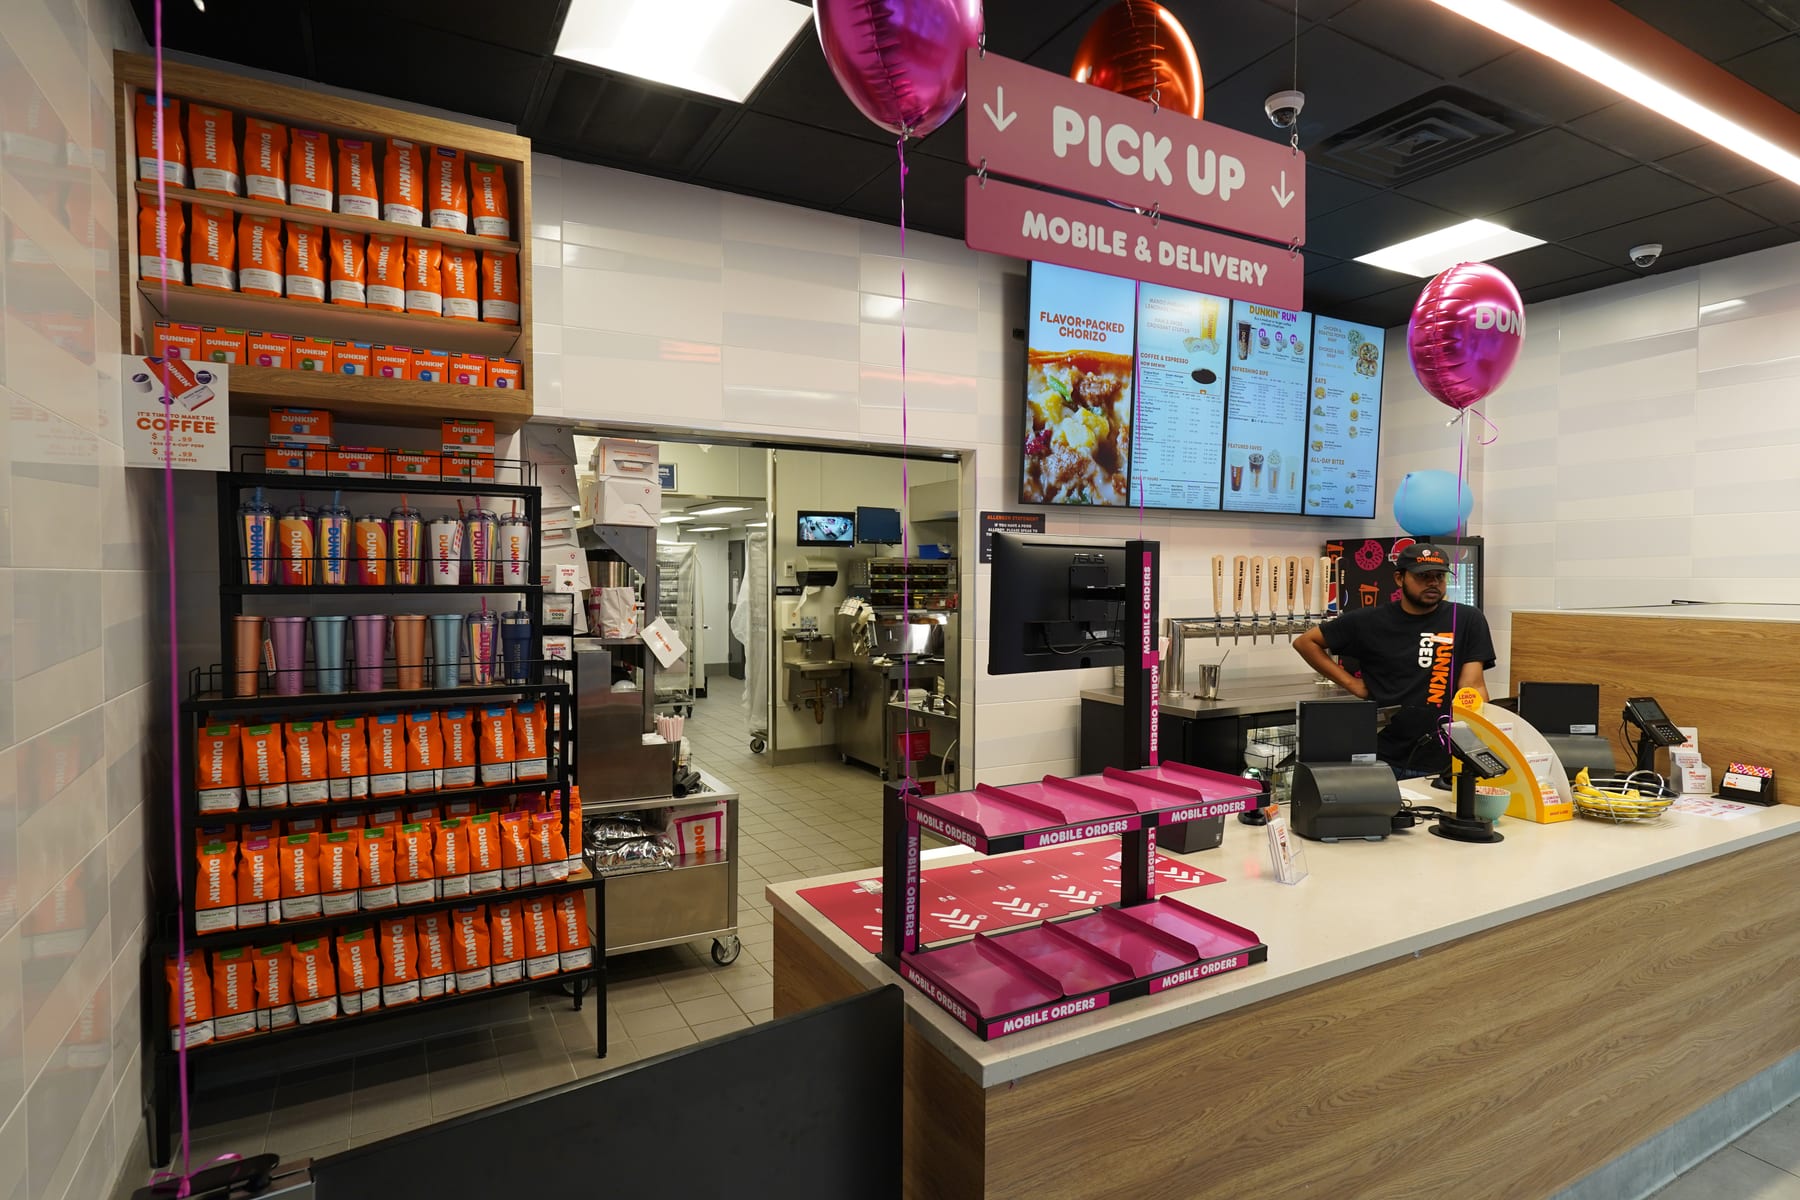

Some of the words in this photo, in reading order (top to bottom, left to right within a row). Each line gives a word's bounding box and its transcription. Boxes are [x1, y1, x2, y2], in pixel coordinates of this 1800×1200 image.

[1052, 105, 1173, 186] PICK
[1186, 144, 1246, 202] UP
[1022, 209, 1128, 257] MOBILE
[1134, 235, 1152, 263] &
[1158, 245, 1268, 287] DELIVERY
[1040, 311, 1125, 334] FLAVOR-PACKED
[1249, 305, 1280, 319] DUNKIN'
[1281, 312, 1297, 322] RUN
[1058, 326, 1107, 342] CHORIZO
[136, 417, 216, 434] COFFEE
[1365, 595, 1373, 605] D
[1143, 613, 1151, 654] MOBILE
[1418, 632, 1434, 668] ICED
[1171, 807, 1207, 823] MOBILE
[1210, 800, 1246, 816] ORDERS
[917, 811, 944, 835] MOBILE
[945, 823, 977, 848] ORDERS
[1039, 829, 1083, 847] MOBILE
[1083, 820, 1128, 840] ORDERS
[907, 836, 917, 885] MOBILE
[906, 885, 916, 937] ORDERS
[1162, 968, 1199, 988] MOBILE
[1201, 957, 1237, 977] ORDERS
[908, 969, 936, 1000] MOBILE
[937, 990, 967, 1023] ORDERS
[1003, 1012, 1048, 1033] MOBILE
[1051, 998, 1096, 1020] ORDERS
